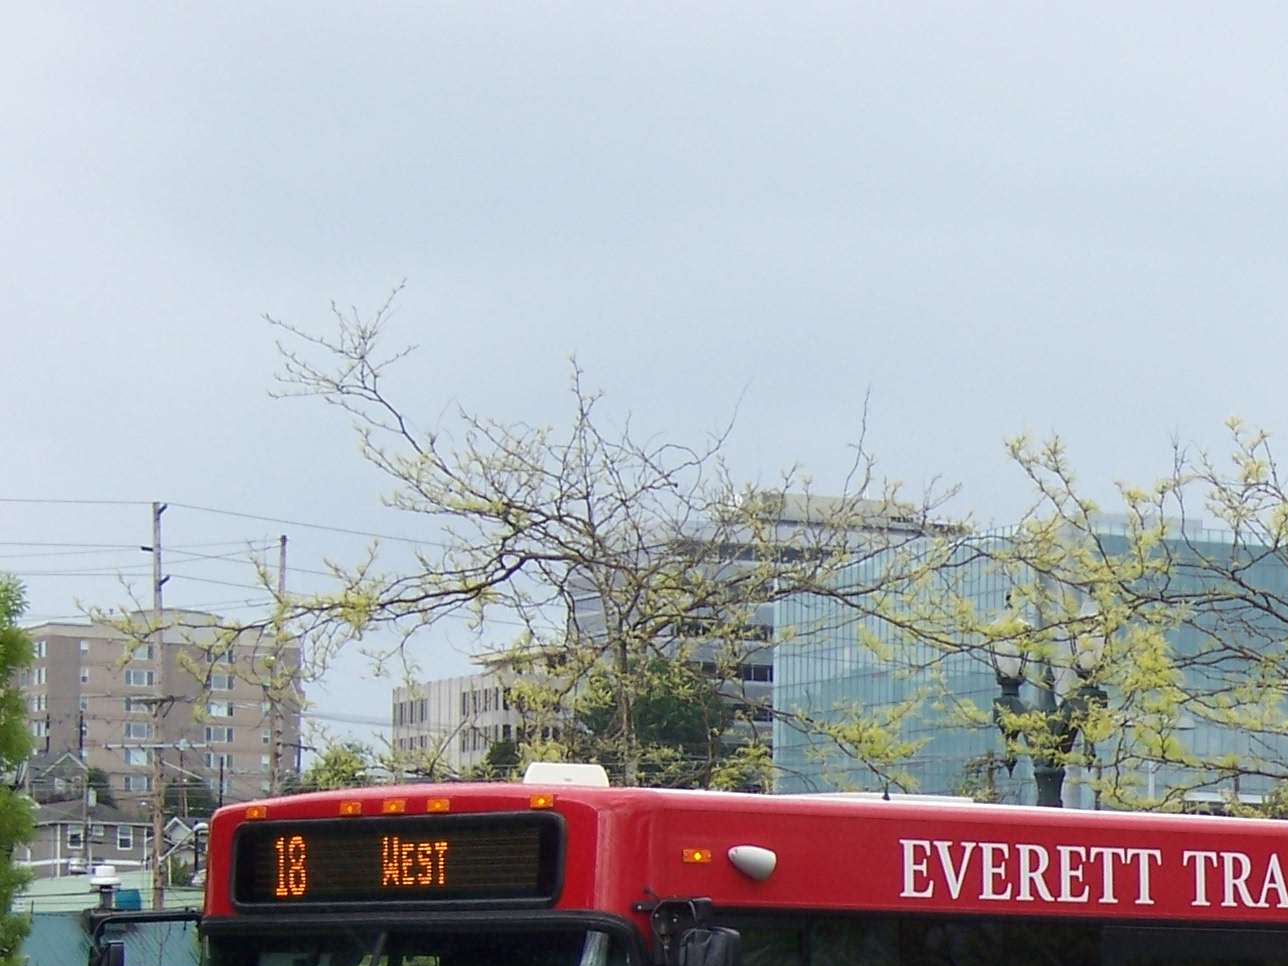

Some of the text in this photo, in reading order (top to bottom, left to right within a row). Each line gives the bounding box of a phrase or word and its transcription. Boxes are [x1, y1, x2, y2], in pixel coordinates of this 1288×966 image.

[275, 835, 448, 896] 18 WEST
[899, 838, 1161, 905] EVERETT
